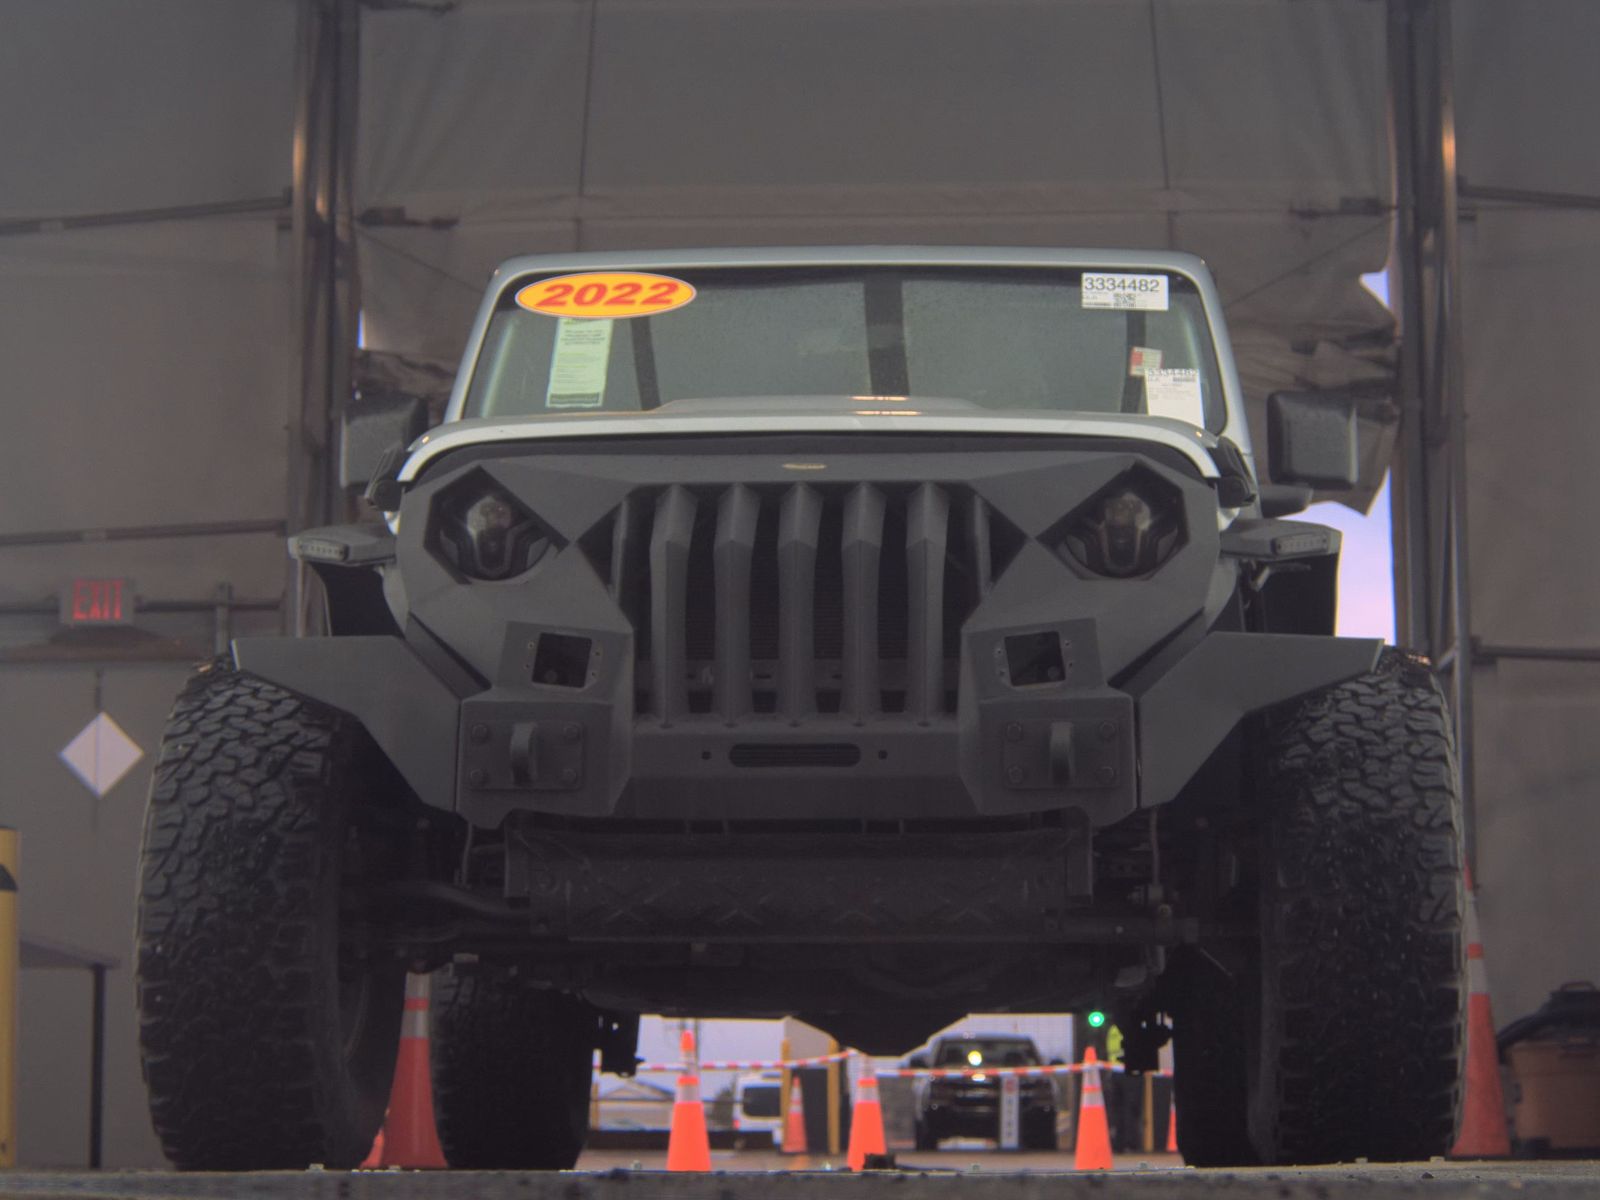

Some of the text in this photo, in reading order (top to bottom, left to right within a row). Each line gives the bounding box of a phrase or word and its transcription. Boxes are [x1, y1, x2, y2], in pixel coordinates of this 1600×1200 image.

[536, 282, 680, 307] 2022
[1084, 277, 1160, 292] 3334482
[73, 579, 125, 620] EXIT
